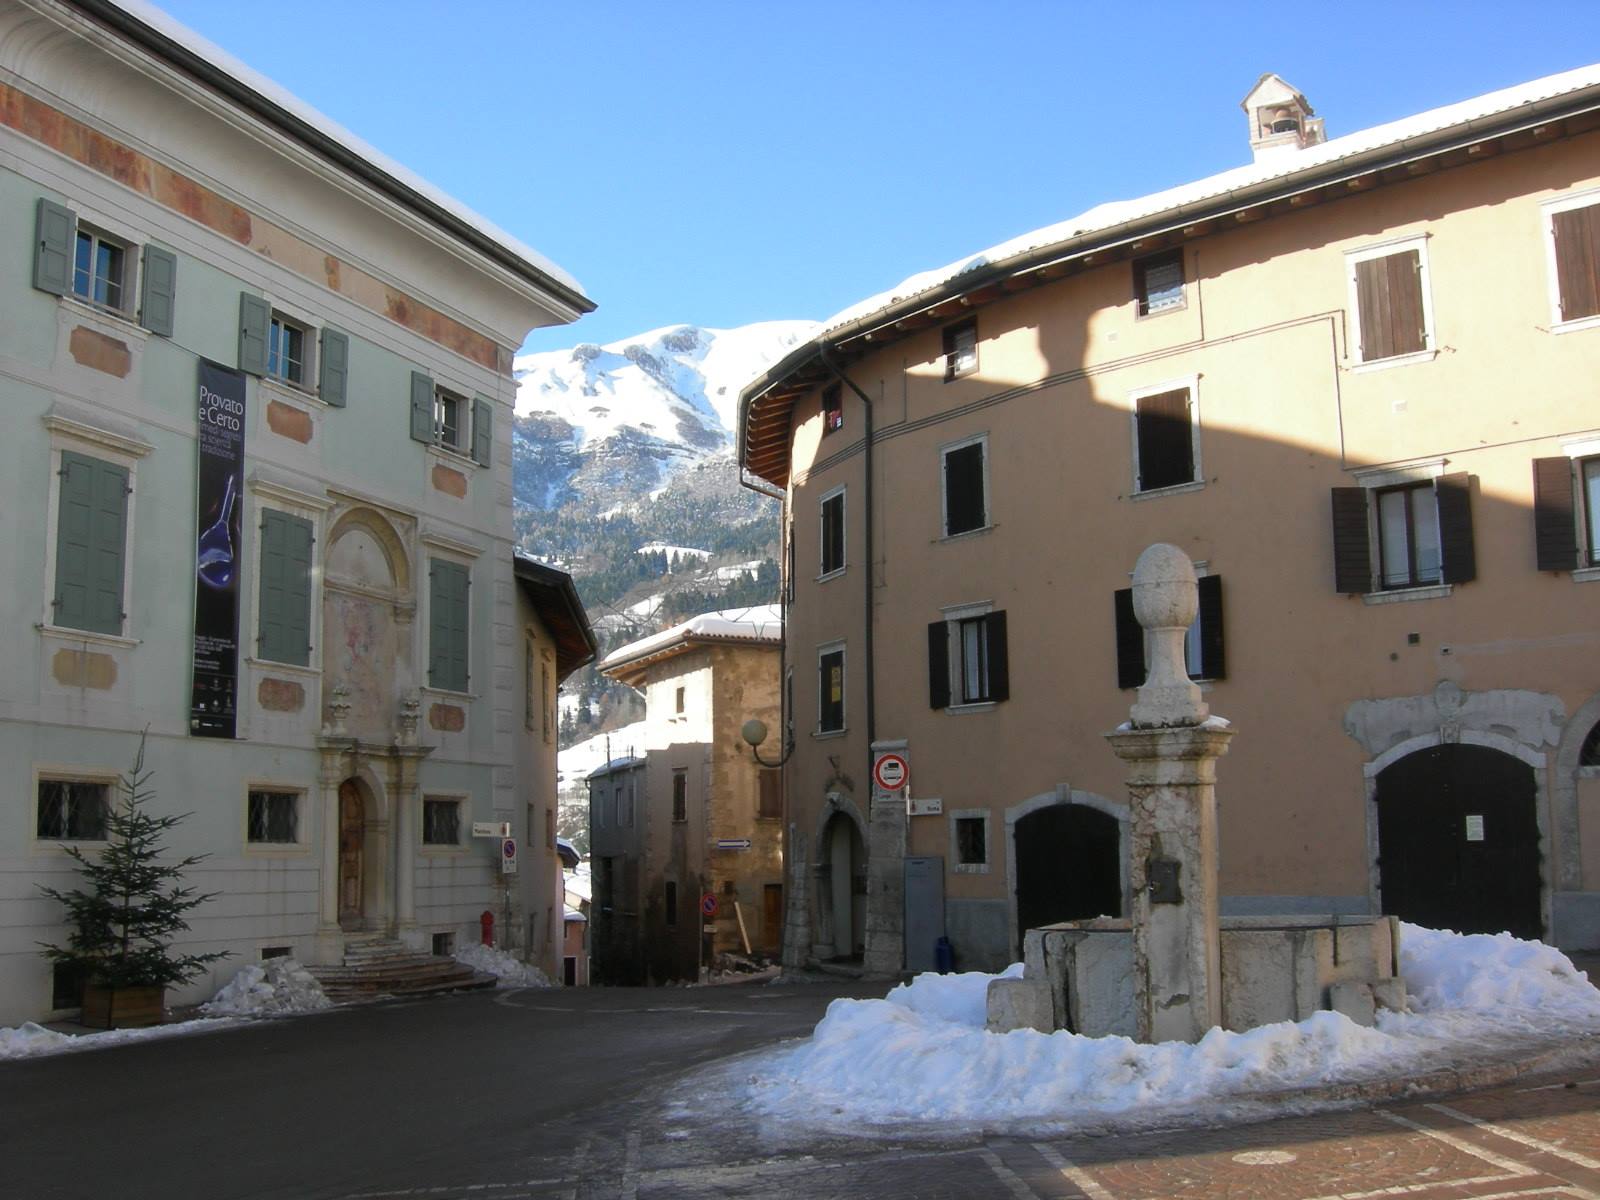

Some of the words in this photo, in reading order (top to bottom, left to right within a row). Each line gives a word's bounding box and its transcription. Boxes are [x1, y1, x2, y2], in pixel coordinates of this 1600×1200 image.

[200, 386, 243, 415] Provato
[199, 407, 206, 421] e
[208, 407, 240, 431] Certo
